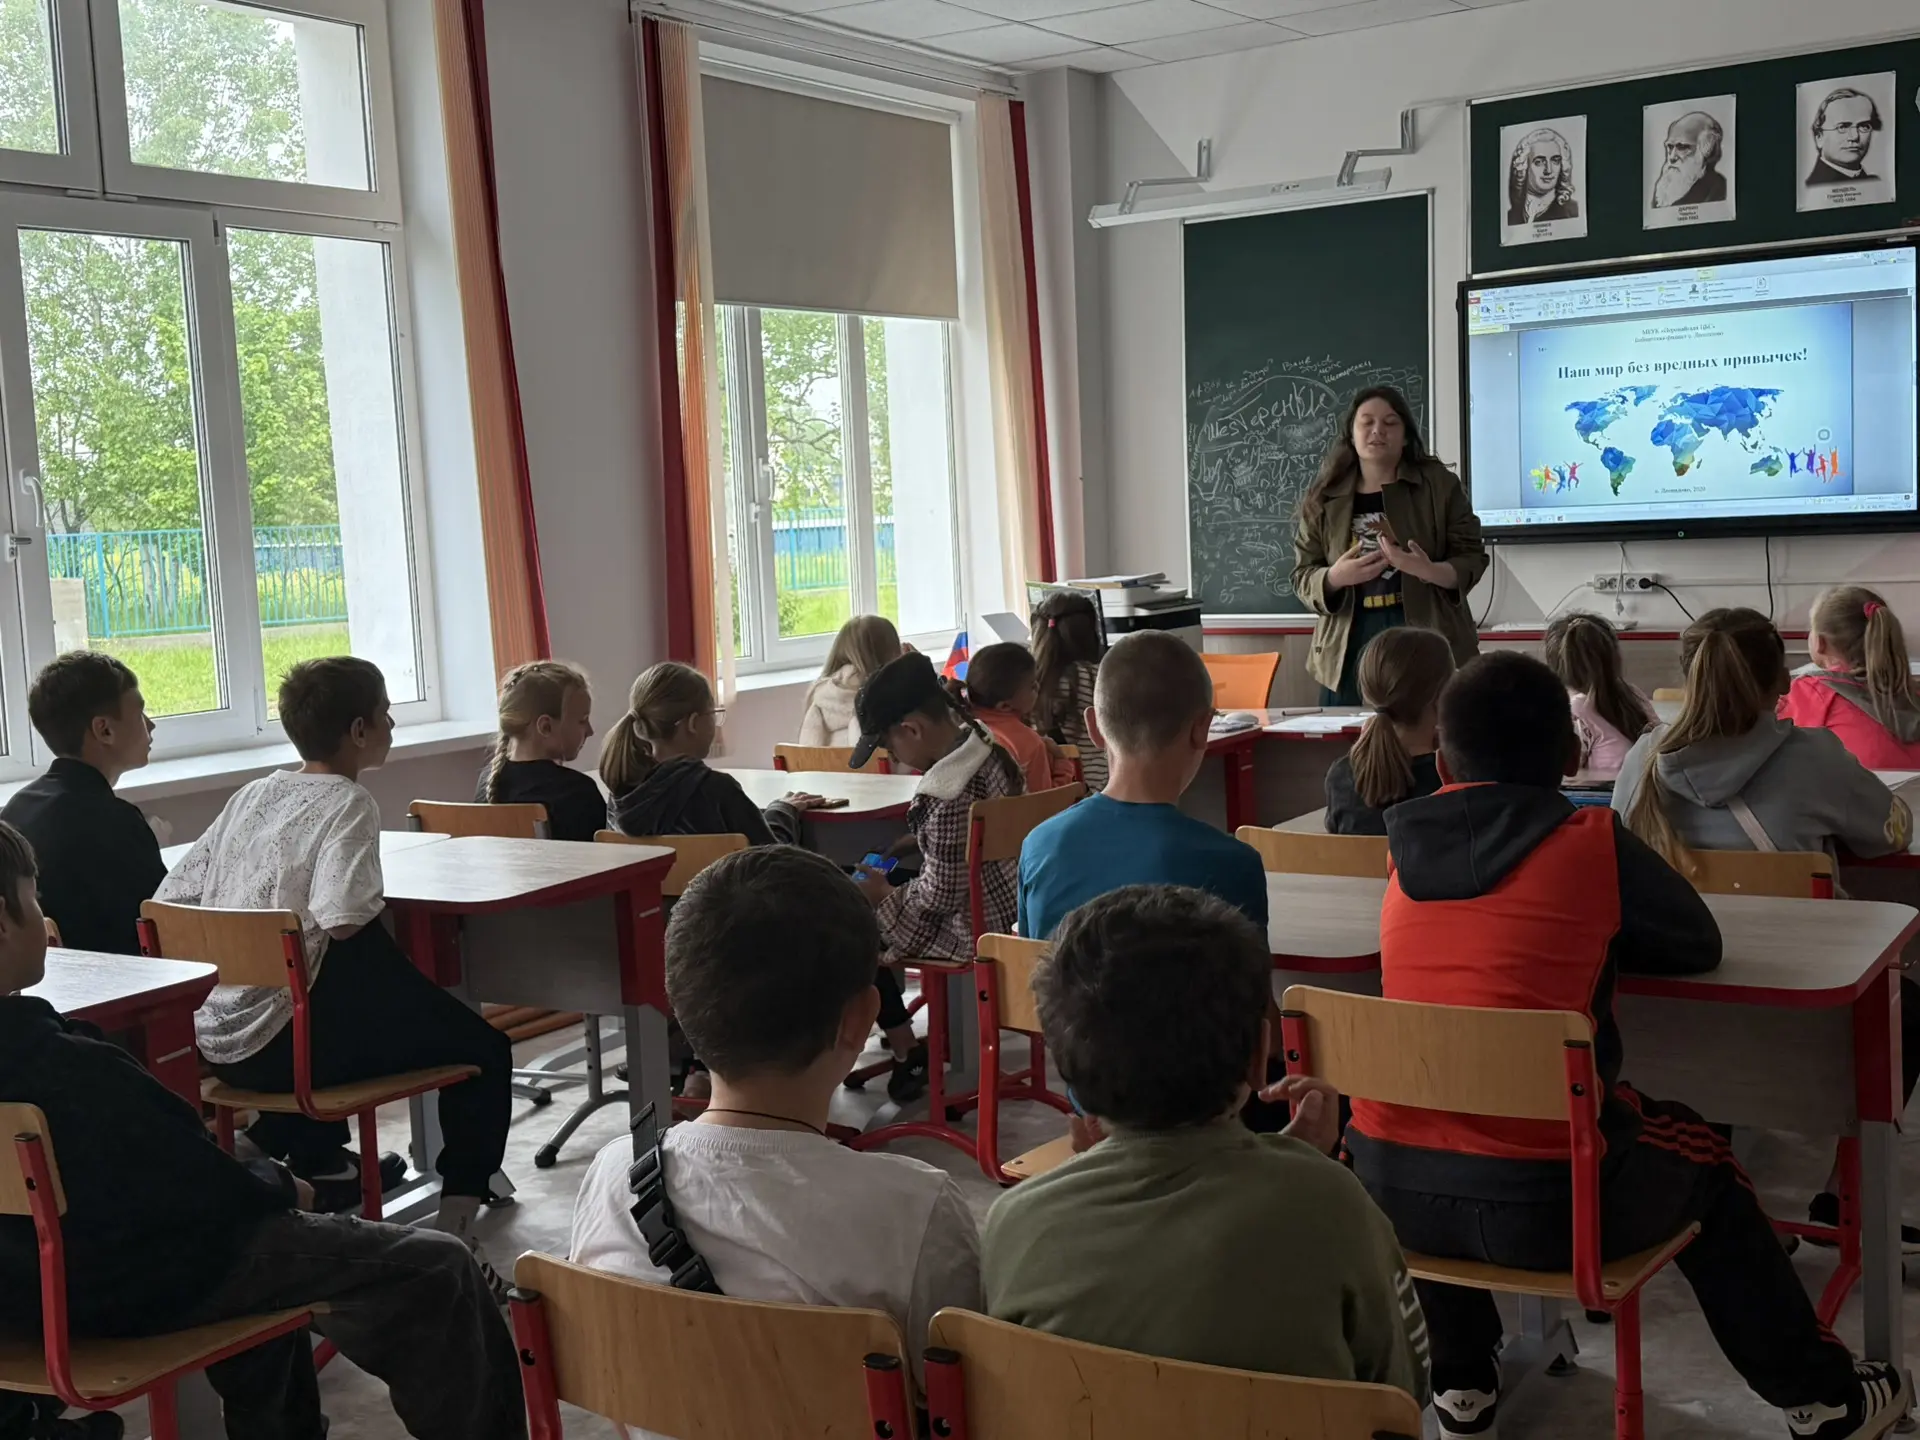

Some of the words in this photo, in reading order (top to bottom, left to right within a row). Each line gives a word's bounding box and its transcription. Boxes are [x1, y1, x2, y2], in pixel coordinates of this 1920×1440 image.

[1558, 366, 1590, 379] Наш
[1594, 365, 1624, 378] мир
[1627, 361, 1650, 374] без
[1654, 358, 1718, 374] вредных
[1723, 347, 1808, 369] привычек!
